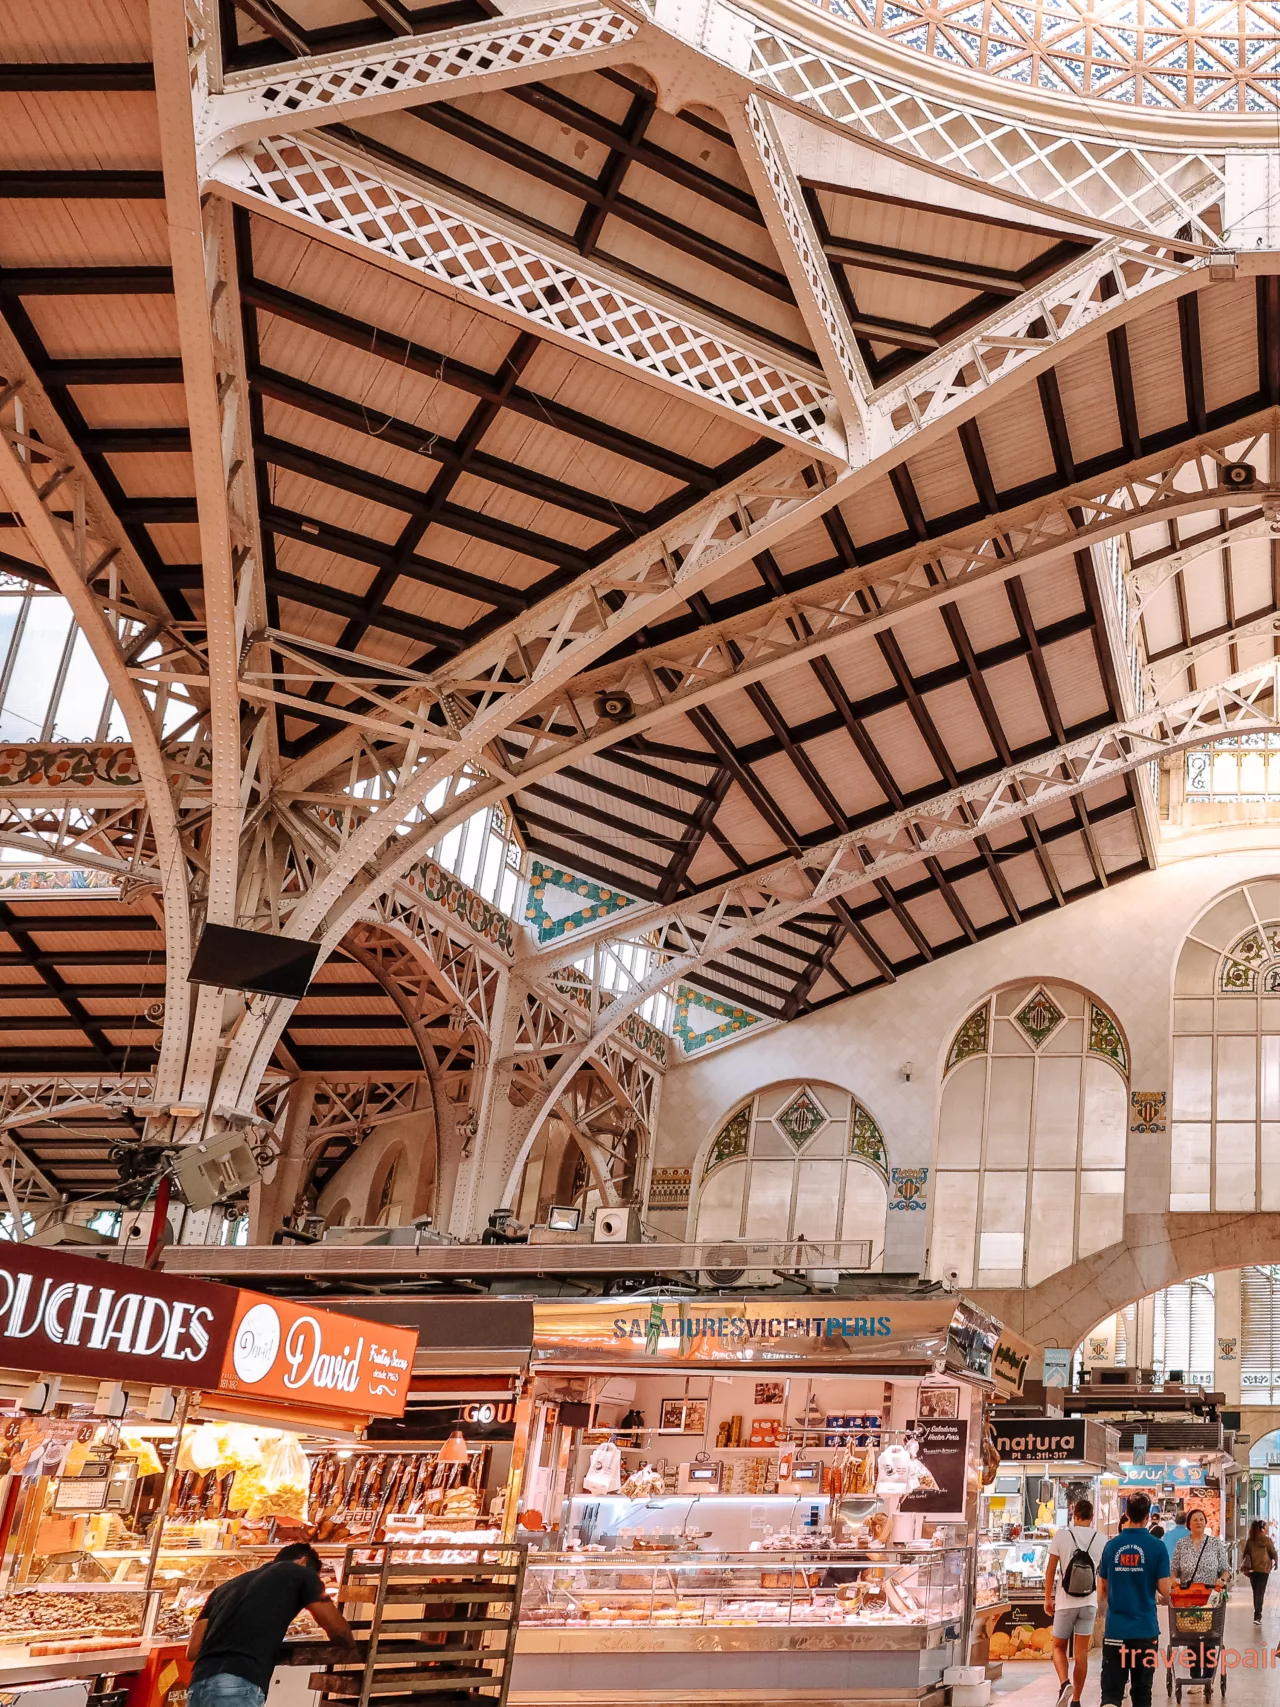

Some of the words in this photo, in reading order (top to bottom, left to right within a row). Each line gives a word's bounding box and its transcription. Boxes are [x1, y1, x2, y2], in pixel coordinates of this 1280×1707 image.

[283, 1316, 364, 1393] David
[6, 1423, 19, 1437] 3€
[79, 1427, 92, 1440] 2€
[996, 1433, 1075, 1451] natura
